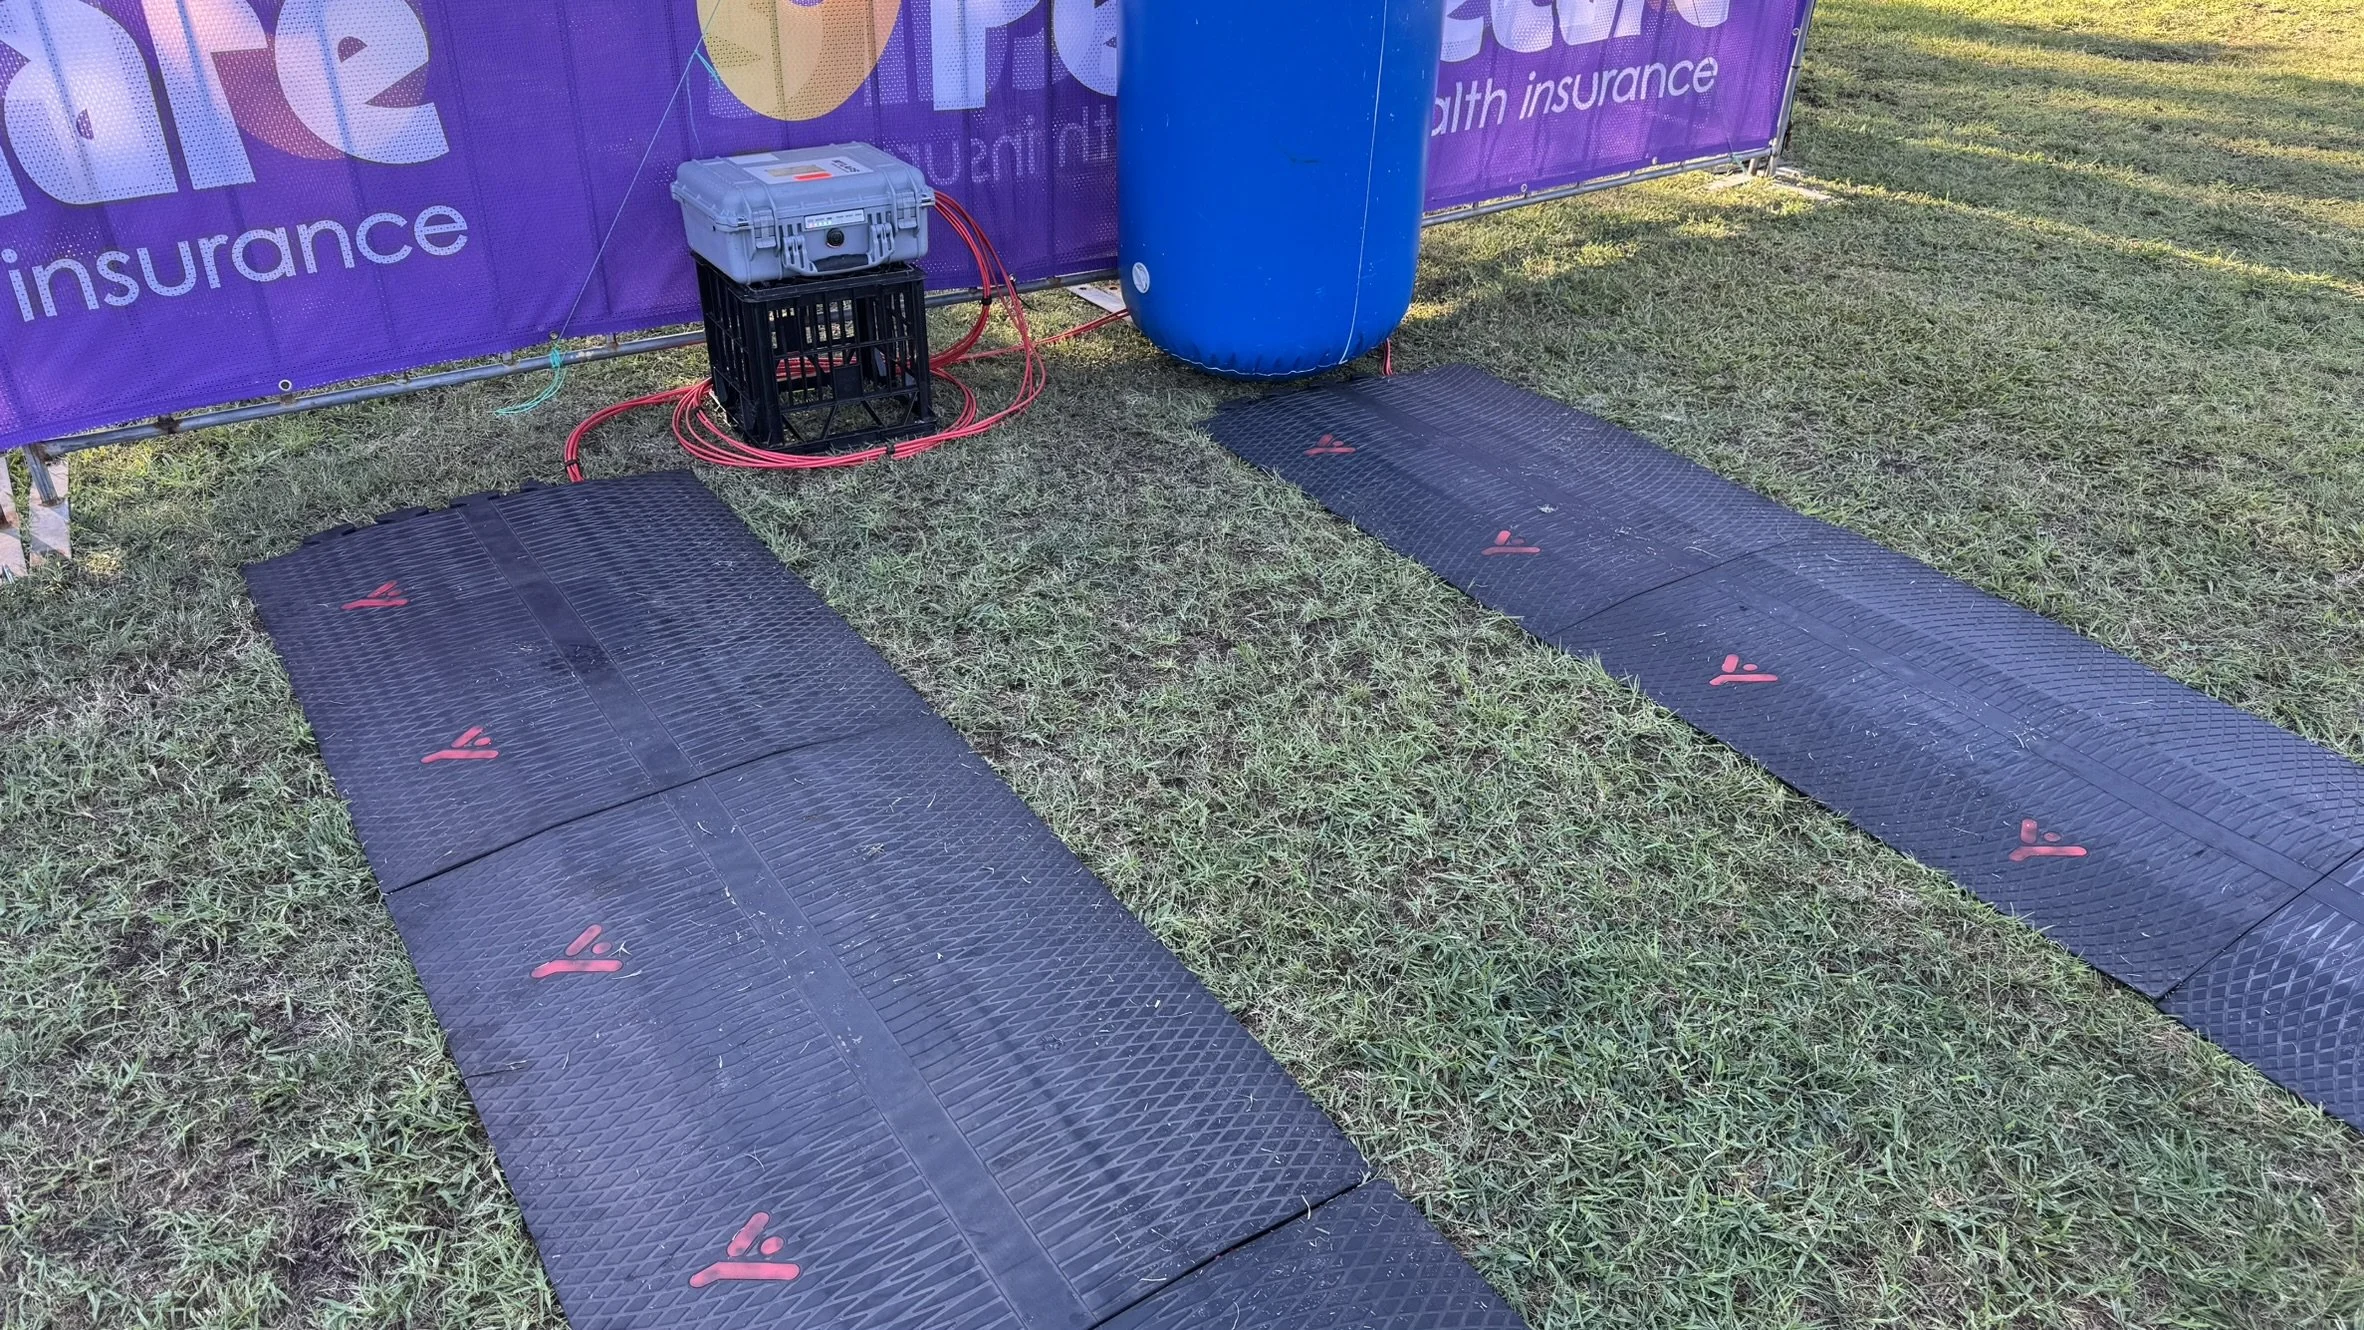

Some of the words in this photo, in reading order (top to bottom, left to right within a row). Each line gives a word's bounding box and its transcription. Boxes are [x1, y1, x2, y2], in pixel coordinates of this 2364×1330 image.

[0, 0, 450, 216] are
[1431, 78, 1507, 137] alth
[1519, 56, 1719, 120] insurance
[1, 205, 469, 322] insurance
